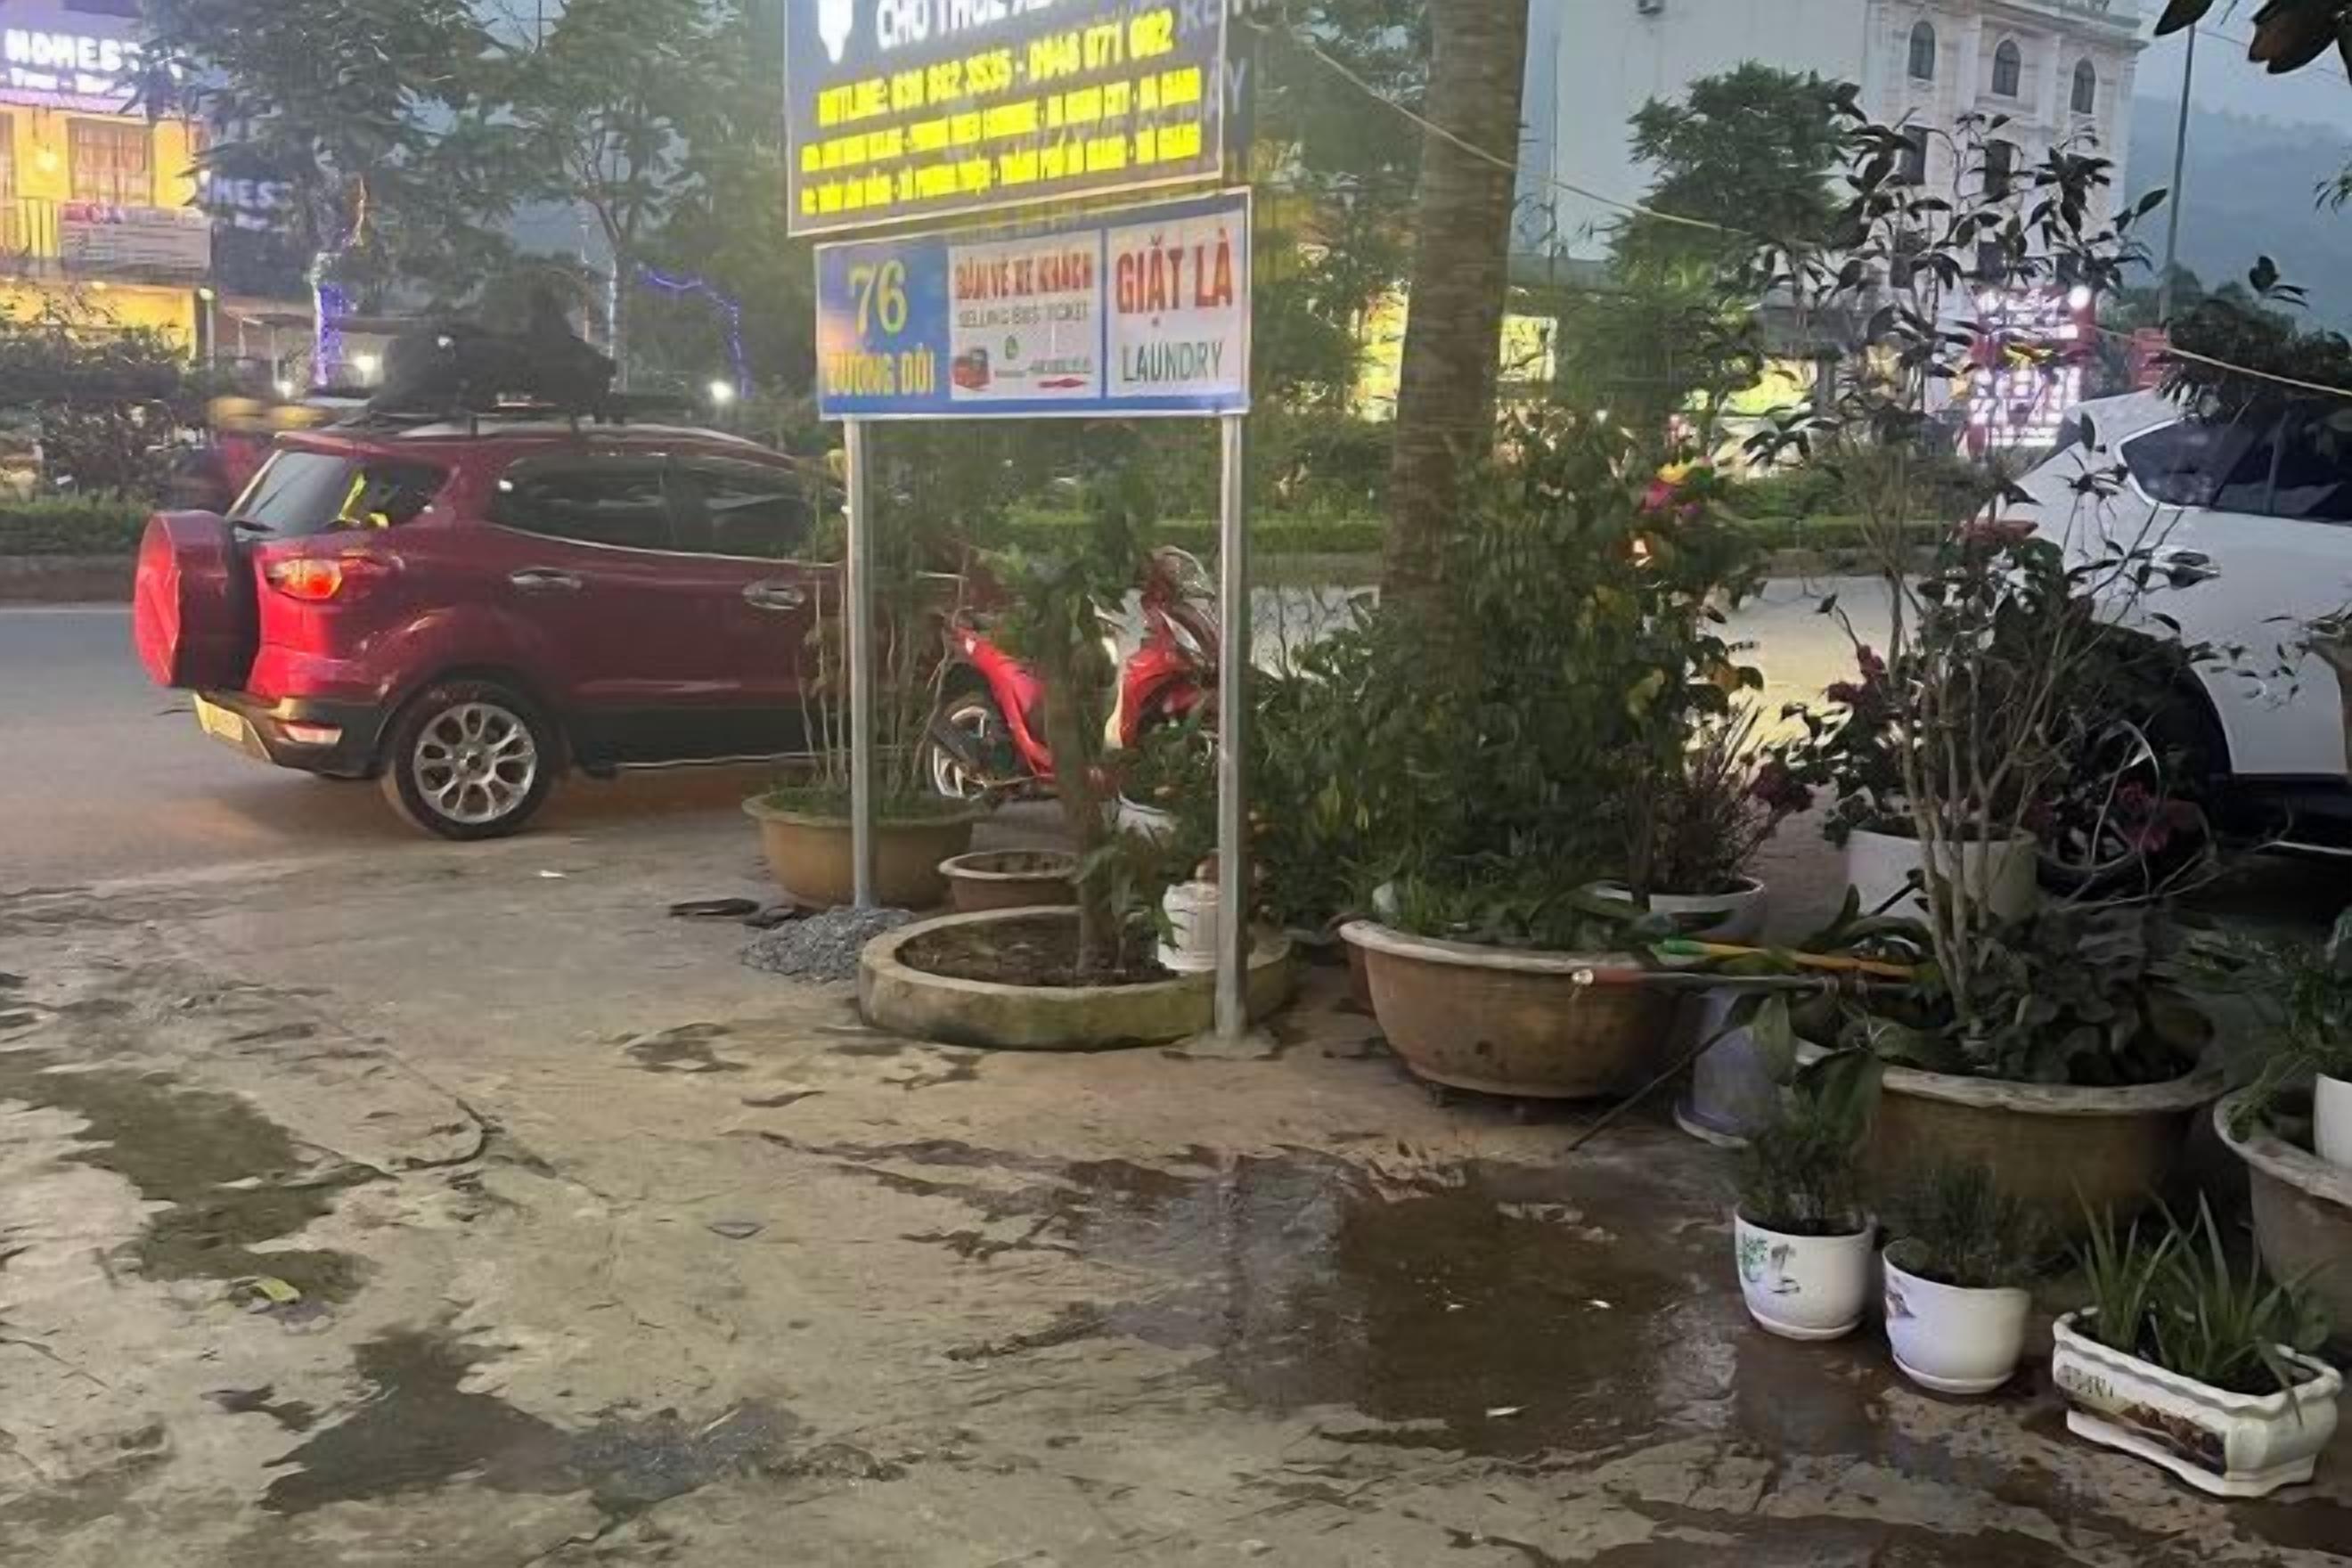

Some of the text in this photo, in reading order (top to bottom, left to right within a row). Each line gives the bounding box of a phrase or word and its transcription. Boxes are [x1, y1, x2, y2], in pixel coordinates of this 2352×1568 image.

[849, 259, 907, 336] 76
[1116, 227, 1233, 327] GIẶT LÀ
[1123, 341, 1225, 381] LAUNDRY
